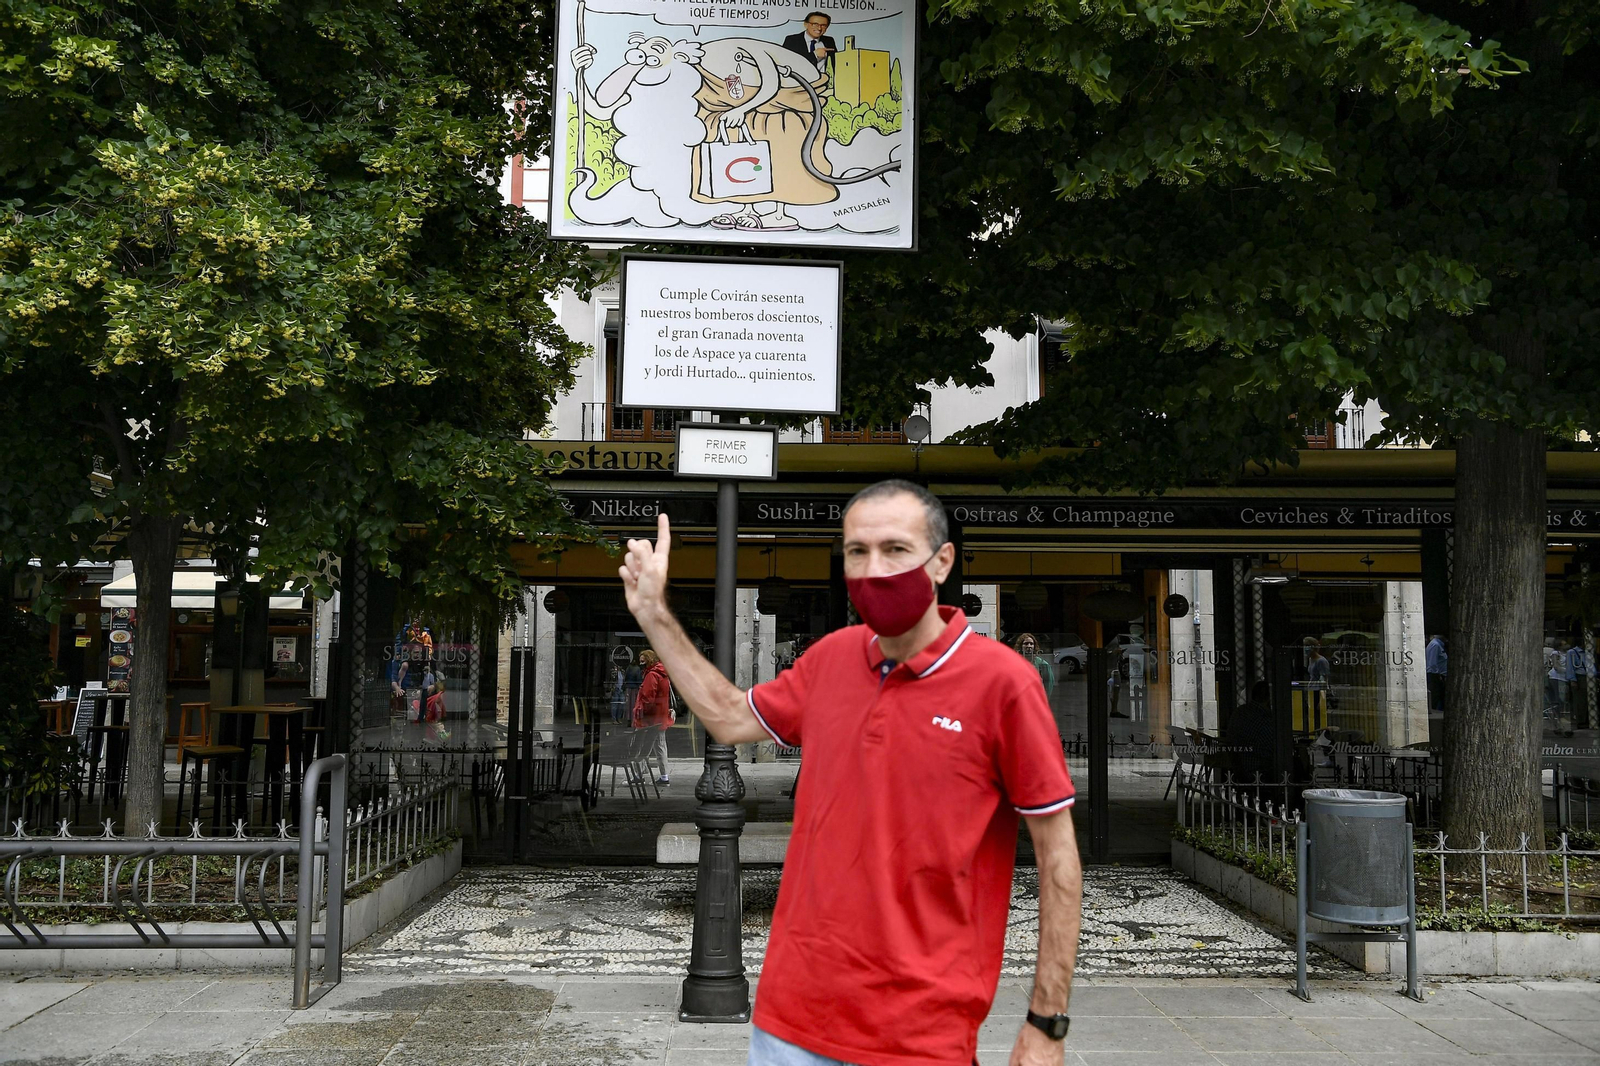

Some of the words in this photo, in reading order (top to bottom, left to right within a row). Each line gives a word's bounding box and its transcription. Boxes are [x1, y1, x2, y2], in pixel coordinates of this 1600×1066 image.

[690, 6, 716, 18] ¡QUÉ
[719, 8, 769, 20] TIEMPOS!
[795, 0, 808, 8] EN
[833, 197, 891, 217] MATUSALÉN
[659, 287, 708, 304] Cumple
[711, 288, 758, 302] Covirán
[761, 293, 805, 304] sesenta
[640, 308, 691, 319] nuestros
[694, 307, 754, 321] bomberos
[757, 309, 823, 325] doscientos,
[658, 326, 669, 338] el
[672, 330, 699, 341] gran
[702, 327, 753, 341] Granada
[757, 332, 804, 342] noventa
[654, 345, 672, 357] los
[674, 346, 689, 358] de
[692, 347, 735, 362] Aspace
[738, 352, 751, 363] ya
[754, 351, 806, 362] cuarenta
[644, 367, 651, 379] y
[654, 364, 683, 379] Jordi
[687, 365, 746, 379] Hurtado...
[749, 368, 816, 383] quinientos.
[706, 439, 747, 450] PRIMER
[704, 453, 748, 465] PREMIO
[589, 499, 660, 517] Nikkei
[953, 506, 1018, 523] Ostras
[1026, 506, 1045, 523] &
[1053, 506, 1175, 528] Champagne
[1240, 507, 1329, 524] Ceviches
[1337, 507, 1355, 525] &
[1362, 507, 1452, 525] Tiraditos
[1570, 509, 1587, 526] &
[932, 715, 963, 733] FILA
